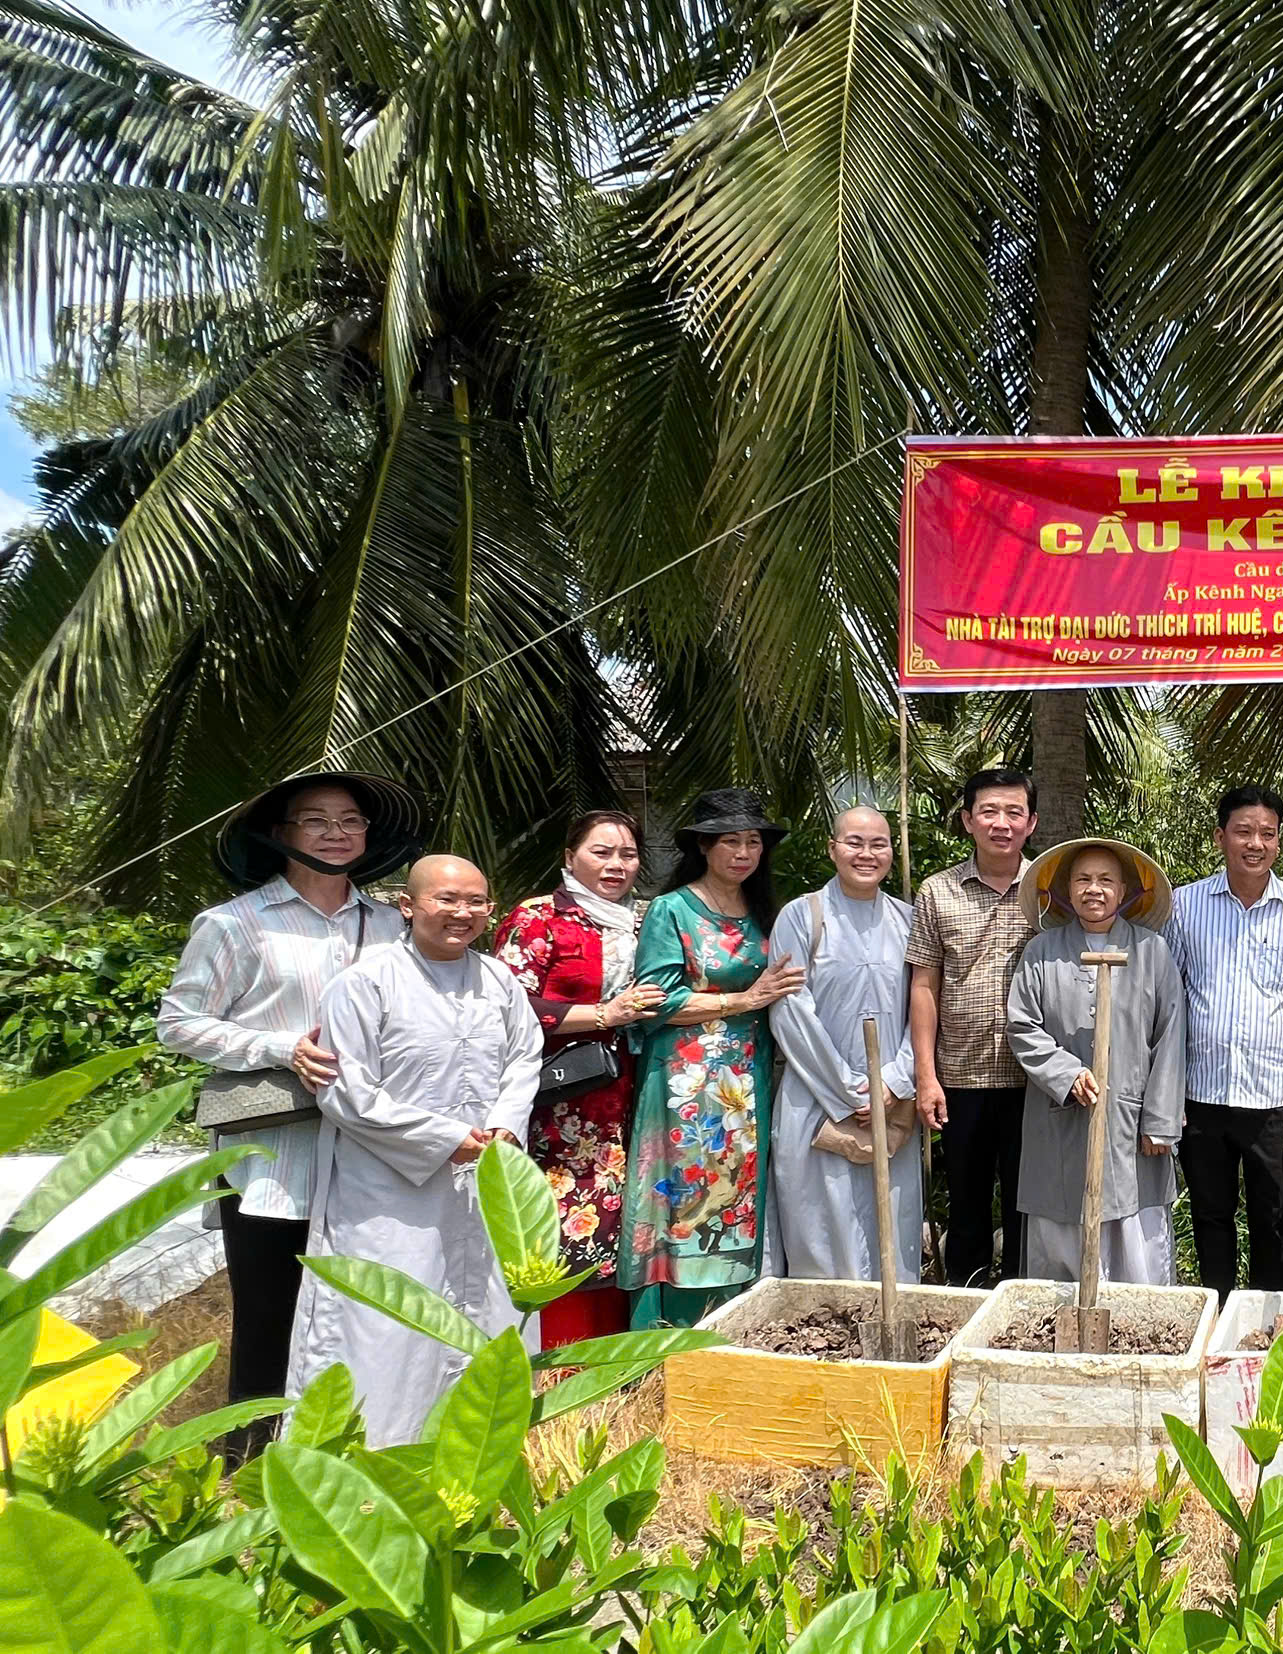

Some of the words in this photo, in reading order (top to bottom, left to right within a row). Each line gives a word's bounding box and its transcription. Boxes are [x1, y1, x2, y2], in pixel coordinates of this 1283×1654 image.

[1117, 457, 1199, 504] LỄ
[1039, 511, 1181, 555] CẦU
[1233, 562, 1270, 578] Cầu
[1163, 581, 1190, 604] Ấp
[1195, 583, 1245, 601] Kênh
[945, 612, 984, 641] NHÀ
[987, 612, 1017, 640] TÀI
[1020, 613, 1056, 645] TRỢ
[1059, 615, 1090, 645] ĐẠI
[1094, 610, 1132, 639] ĐỨC
[1136, 609, 1189, 637] THÍCH
[1193, 608, 1222, 636] TRÍ
[1227, 607, 1268, 640] HUỆ,
[1052, 647, 1103, 664] Ngày
[1107, 647, 1137, 661] 07
[1141, 646, 1198, 663] tháng
[1204, 645, 1218, 660] 7
[1221, 645, 1265, 660] năm
